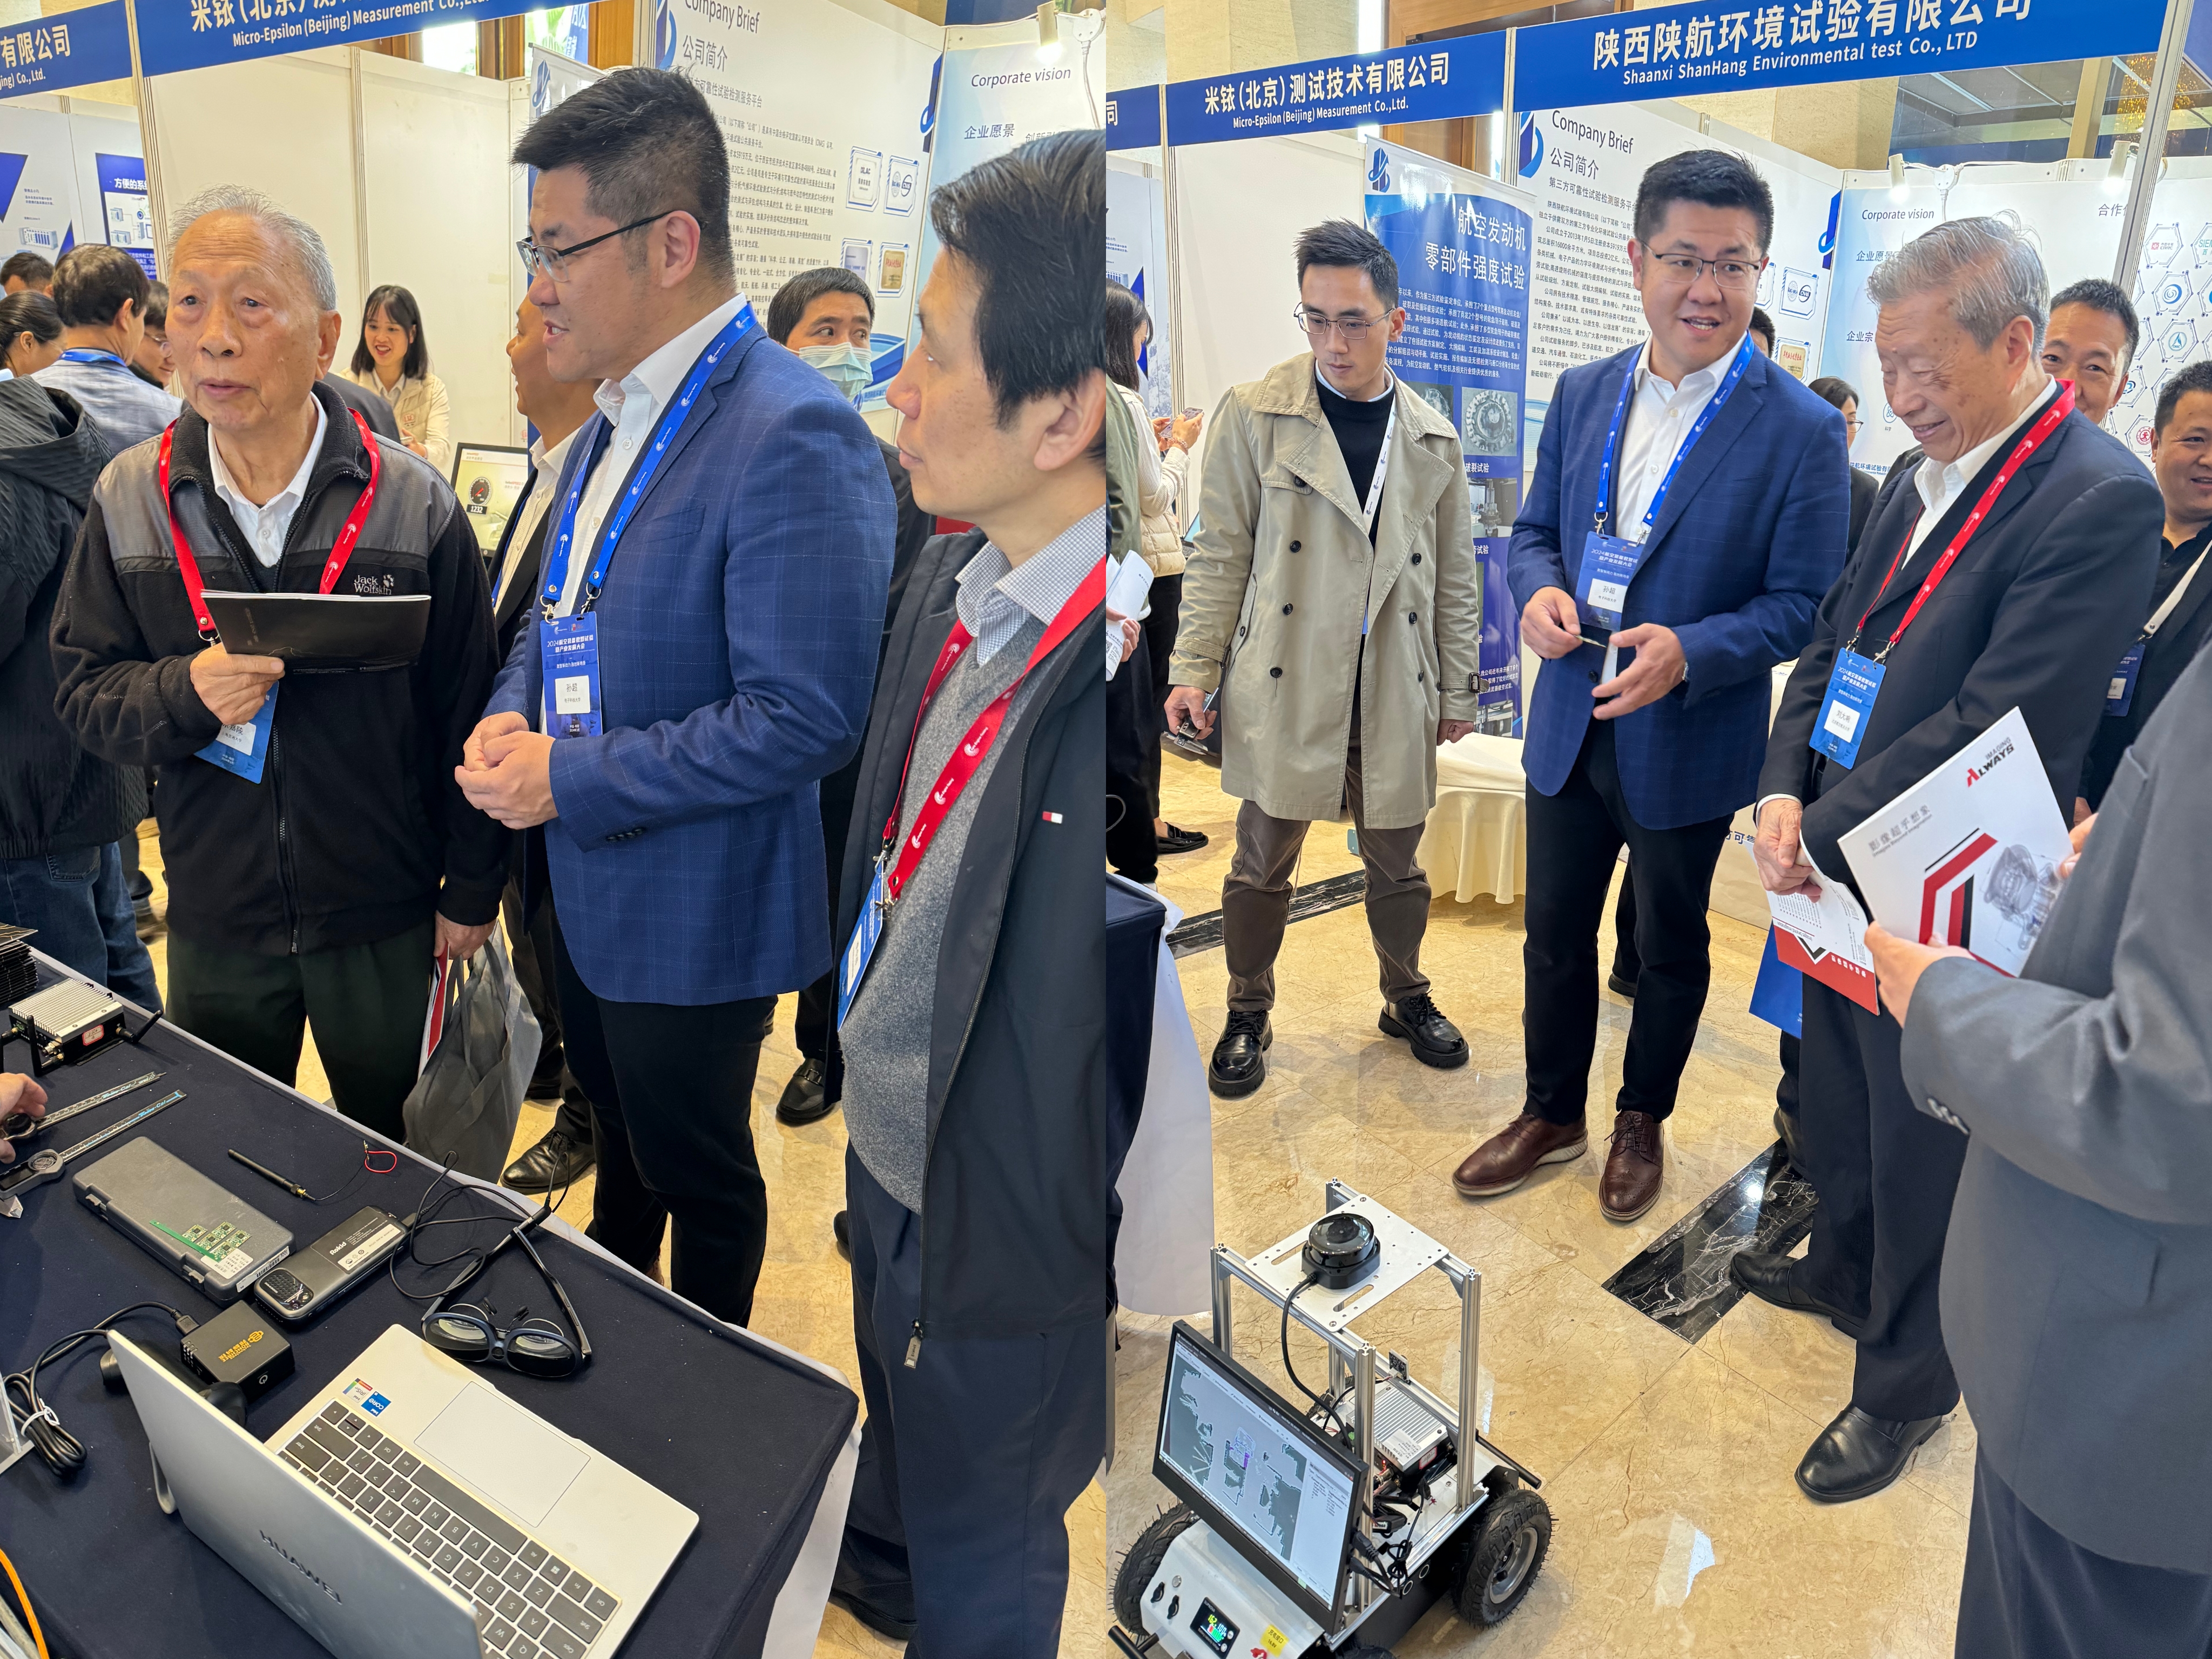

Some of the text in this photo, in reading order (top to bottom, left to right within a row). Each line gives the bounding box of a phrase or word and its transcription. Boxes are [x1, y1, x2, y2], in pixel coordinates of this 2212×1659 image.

[233, 21, 302, 47] Micro-Epsilon
[304, 10, 351, 37] (Beijing)
[353, 0, 434, 25] Measurement
[737, 5, 760, 33] Brief
[1, 24, 70, 69] 有限公司
[683, 35, 727, 72] 公司简介
[1622, 64, 1674, 85] Shaanxi
[1678, 56, 1747, 79] ShanHang
[1752, 42, 1865, 71] Environmental
[1871, 41, 1902, 59] test
[1945, 31, 1978, 51] LTD
[971, 67, 1071, 89] Corporate vision
[691, 77, 763, 108] 方可靠性试验检测服务平台
[1232, 113, 1283, 129] Micro-Epsilon
[1283, 107, 1316, 125] (Beijing)
[1316, 102, 1372, 120] Measurement
[964, 124, 1015, 140] 企业愿景
[1552, 110, 1634, 154] Company Brief
[1549, 147, 1599, 180] 公司简介
[1861, 208, 1934, 221] Corporate vision
[1458, 205, 1527, 252] 航空发动机
[1425, 241, 1525, 290] 零部件强度试验
[1846, 331, 1877, 343] 企业宗
[1465, 462, 1489, 473] 破裂试验
[470, 505, 483, 514] 1232
[354, 575, 379, 585] Jack
[354, 583, 392, 595] Wolfskin
[1985, 737, 2012, 760] IMAGING
[1966, 744, 2015, 788] ALWAYS
[329, 1241, 347, 1256] Rokid
[412, 1497, 421, 1505] M
[260, 1529, 342, 1606] HUAWEI
[513, 1572, 522, 1580] X
[535, 1588, 544, 1596] Z
[495, 1628, 505, 1638] W
[1267, 1628, 1284, 1644] 充电接口
[519, 1645, 528, 1654] Q
